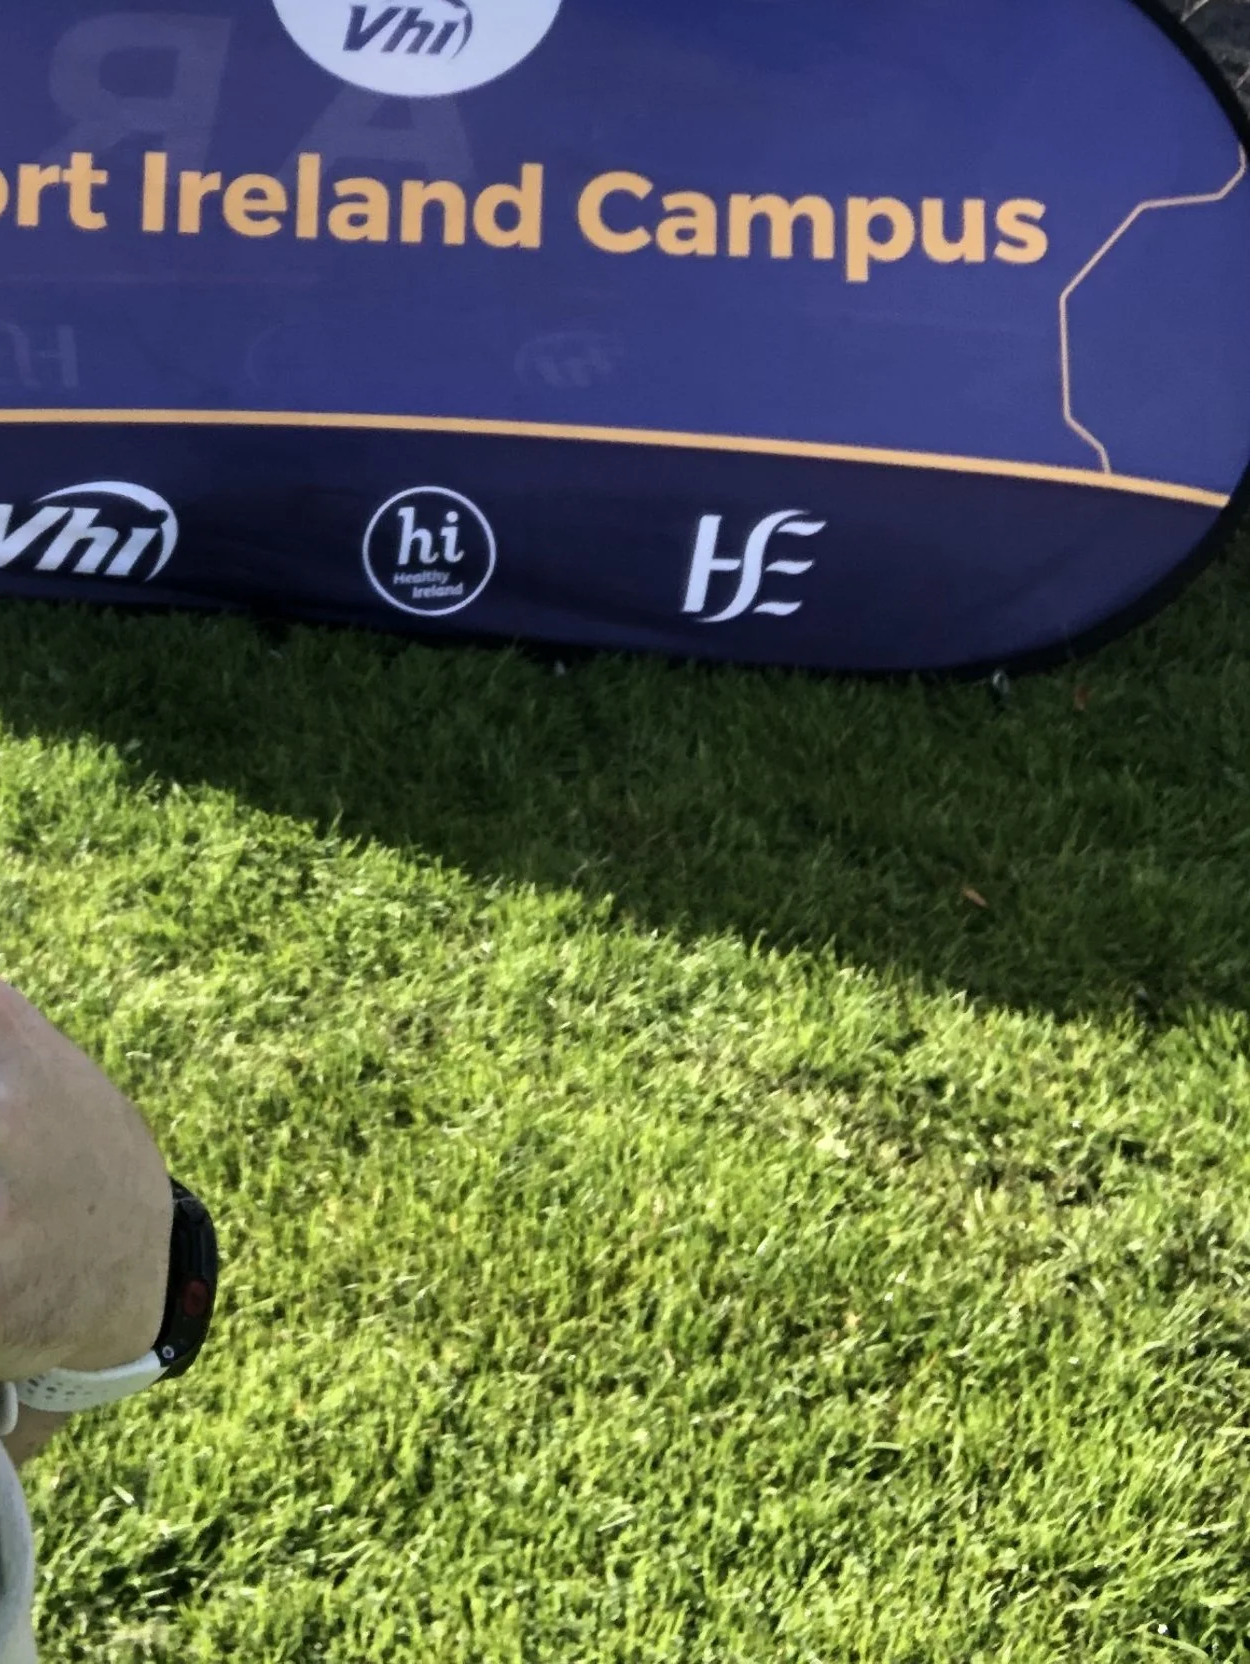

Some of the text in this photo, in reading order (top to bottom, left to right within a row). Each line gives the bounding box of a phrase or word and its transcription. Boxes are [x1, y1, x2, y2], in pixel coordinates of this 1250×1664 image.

[141, 150, 544, 249] Ireland
[577, 170, 1049, 283] Campus
[397, 506, 465, 566] hi
[680, 508, 827, 623] HSE
[393, 570, 451, 585] Healthy
[411, 582, 464, 600] Ireland
